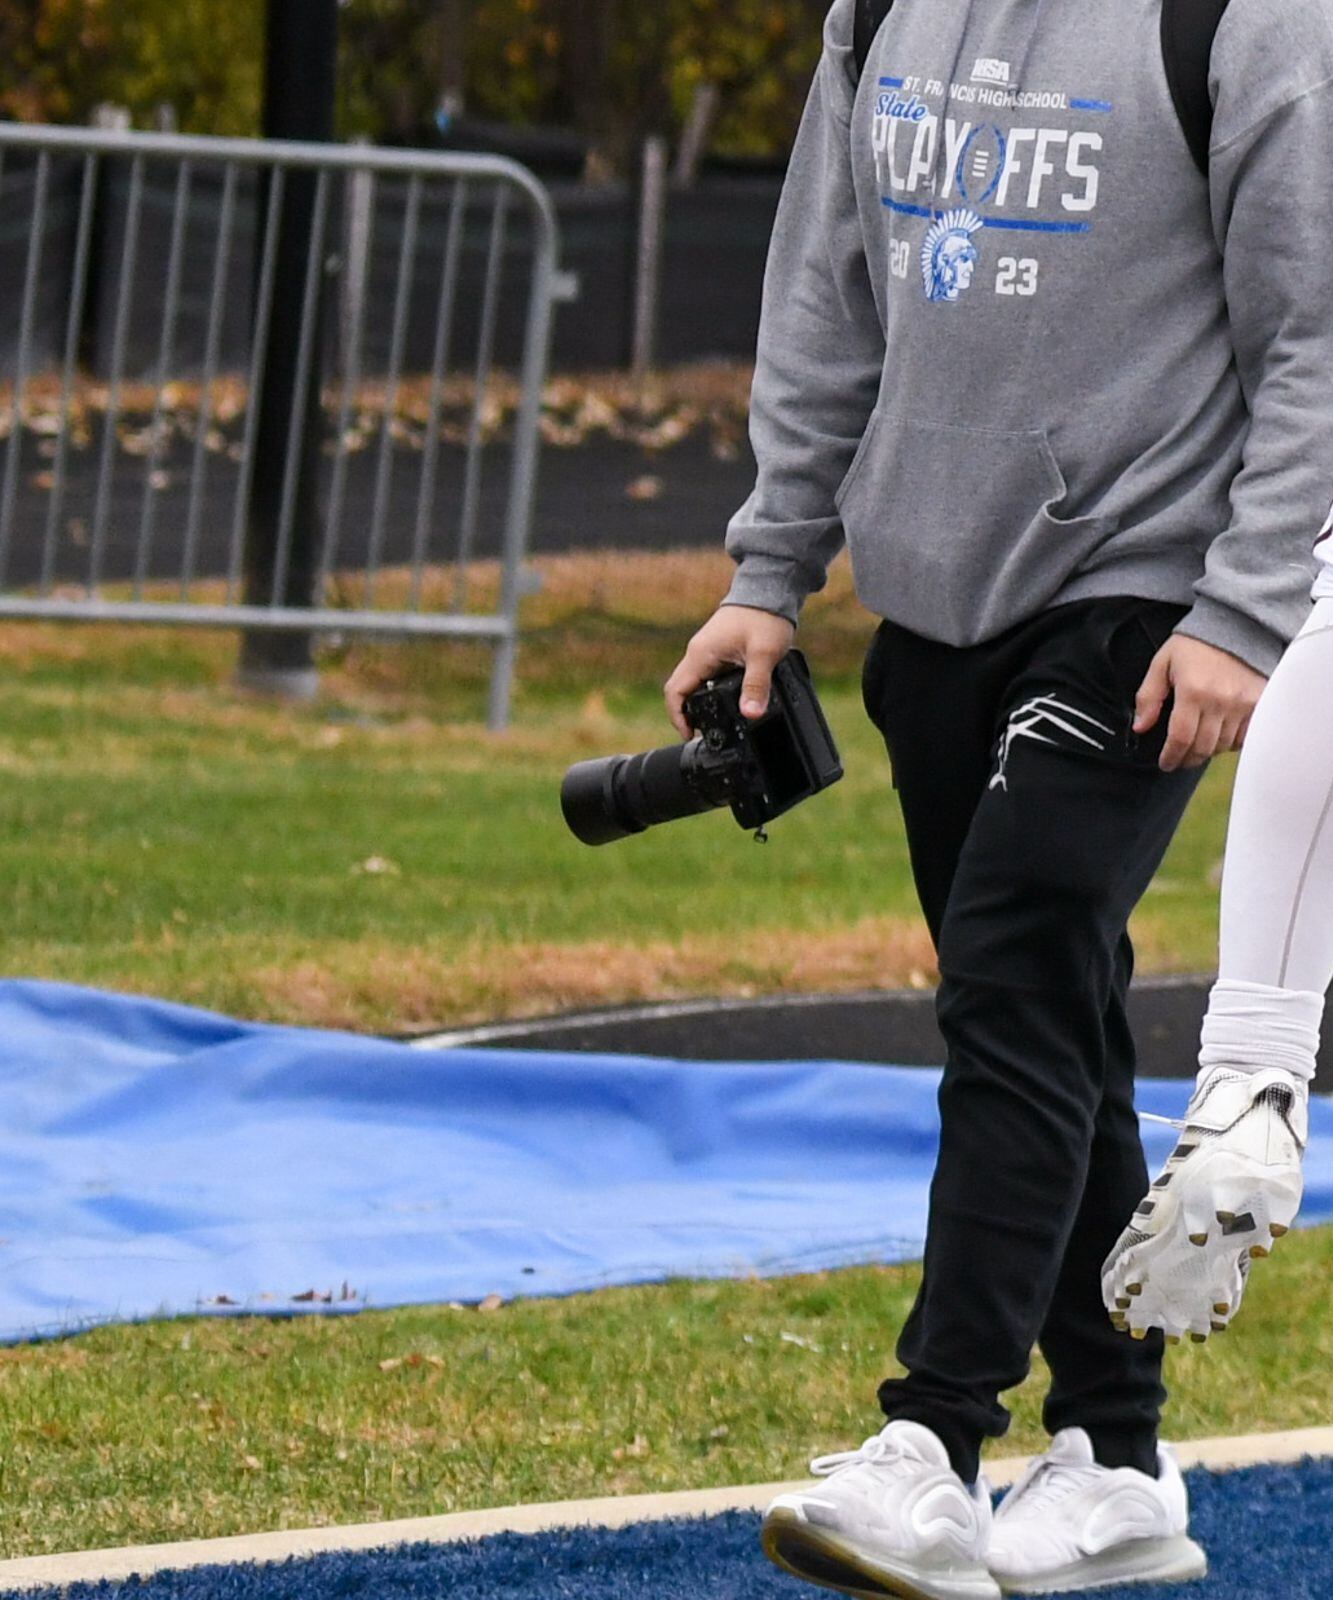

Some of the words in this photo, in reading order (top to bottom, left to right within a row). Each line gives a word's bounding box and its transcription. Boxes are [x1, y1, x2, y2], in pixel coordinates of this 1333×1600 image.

[875, 91, 928, 122] State
[924, 79, 976, 102] FRNCIS
[977, 87, 1014, 108] HIGH
[1014, 90, 1068, 110] SCHOOL
[995, 256, 1039, 296] 23
